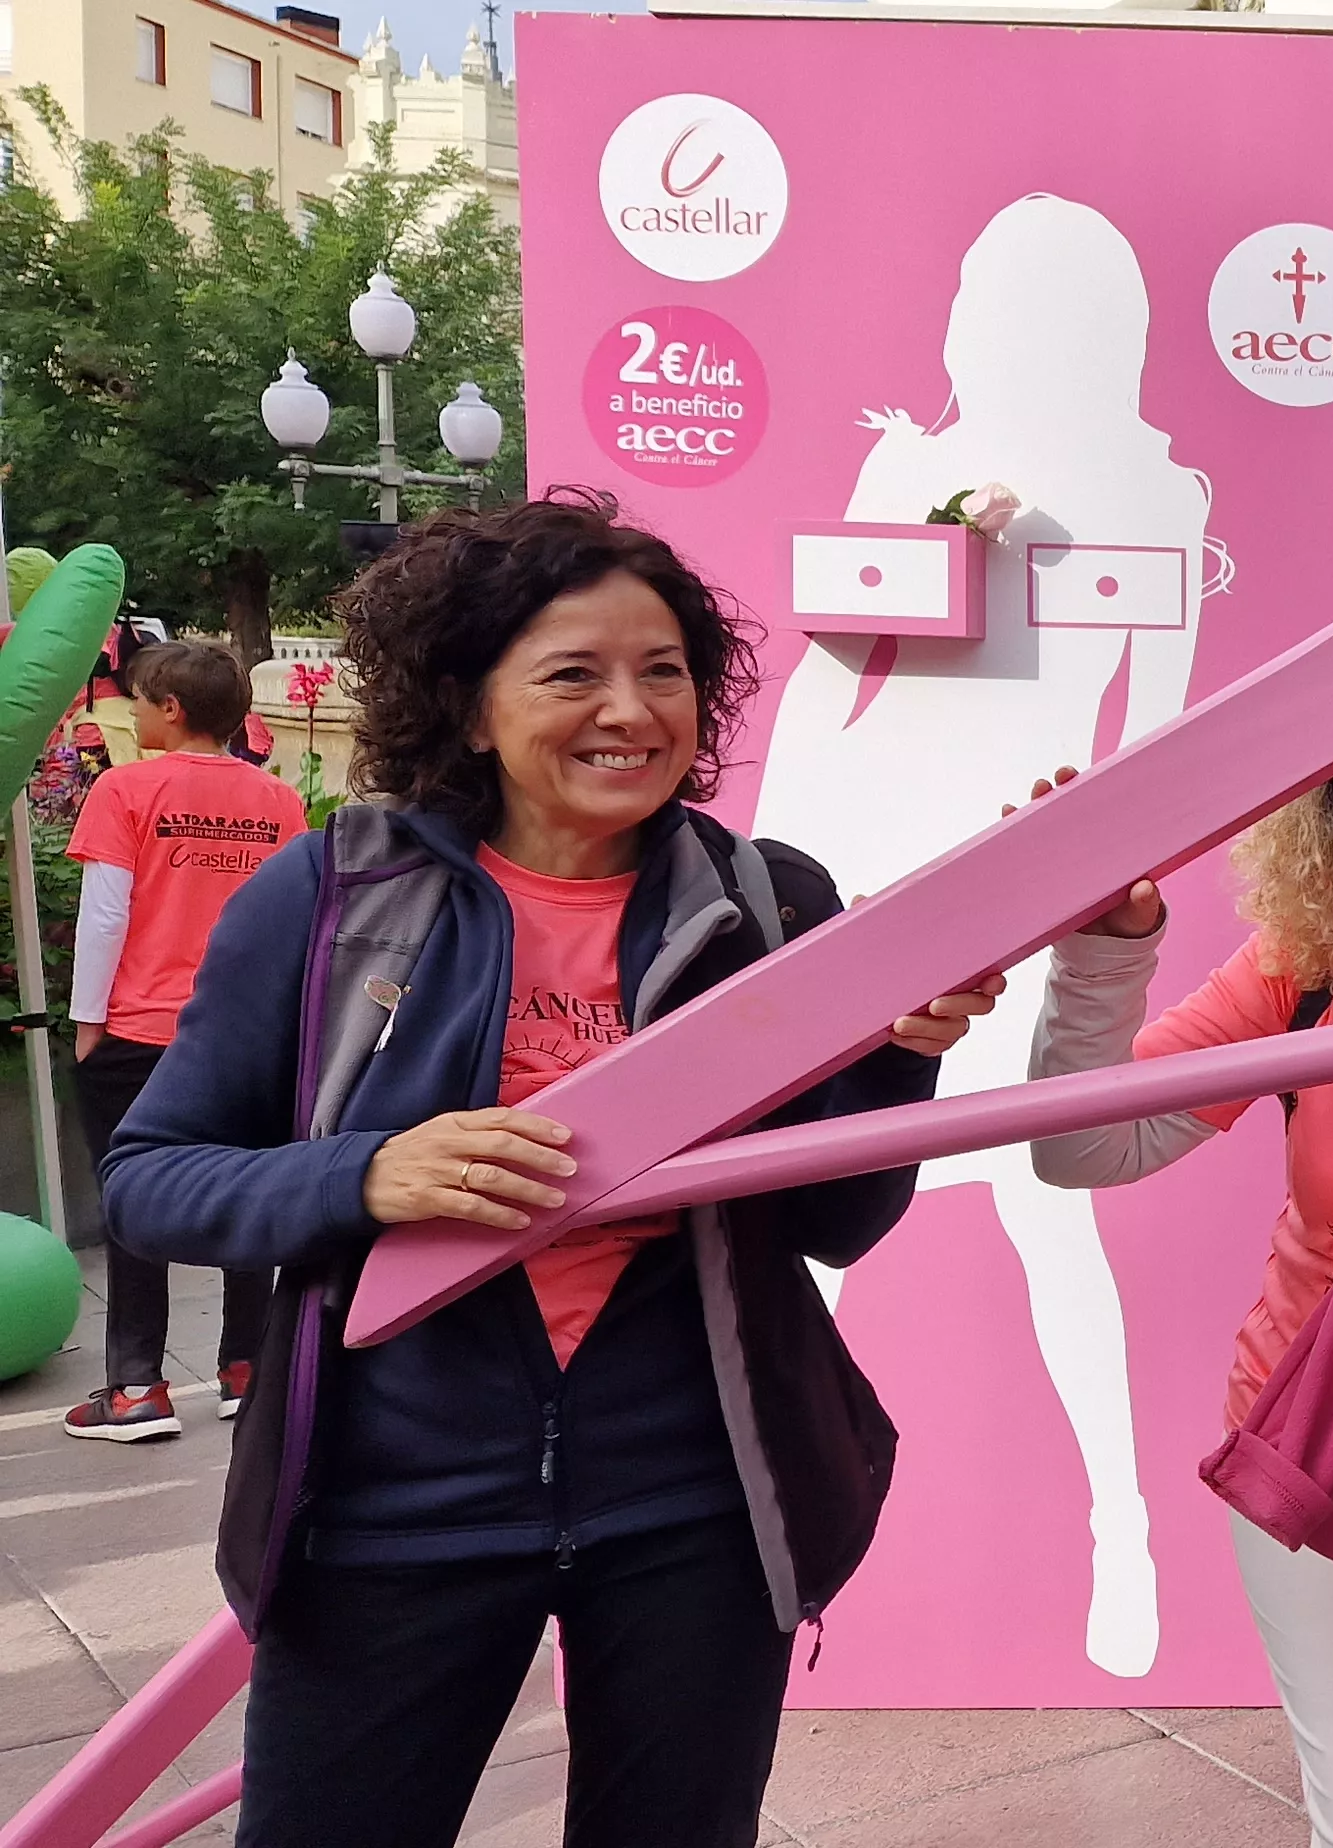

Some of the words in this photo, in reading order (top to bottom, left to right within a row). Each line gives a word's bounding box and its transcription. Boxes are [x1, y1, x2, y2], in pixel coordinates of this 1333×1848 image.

[619, 197, 768, 236] castellar
[1251, 363, 1289, 376] Contra
[1293, 364, 1303, 377] el
[609, 394, 624, 412] a
[631, 389, 744, 420] beneficio
[616, 423, 736, 456] aecc
[156, 813, 280, 833] ALTOARAGÓN
[190, 849, 262, 870] castella
